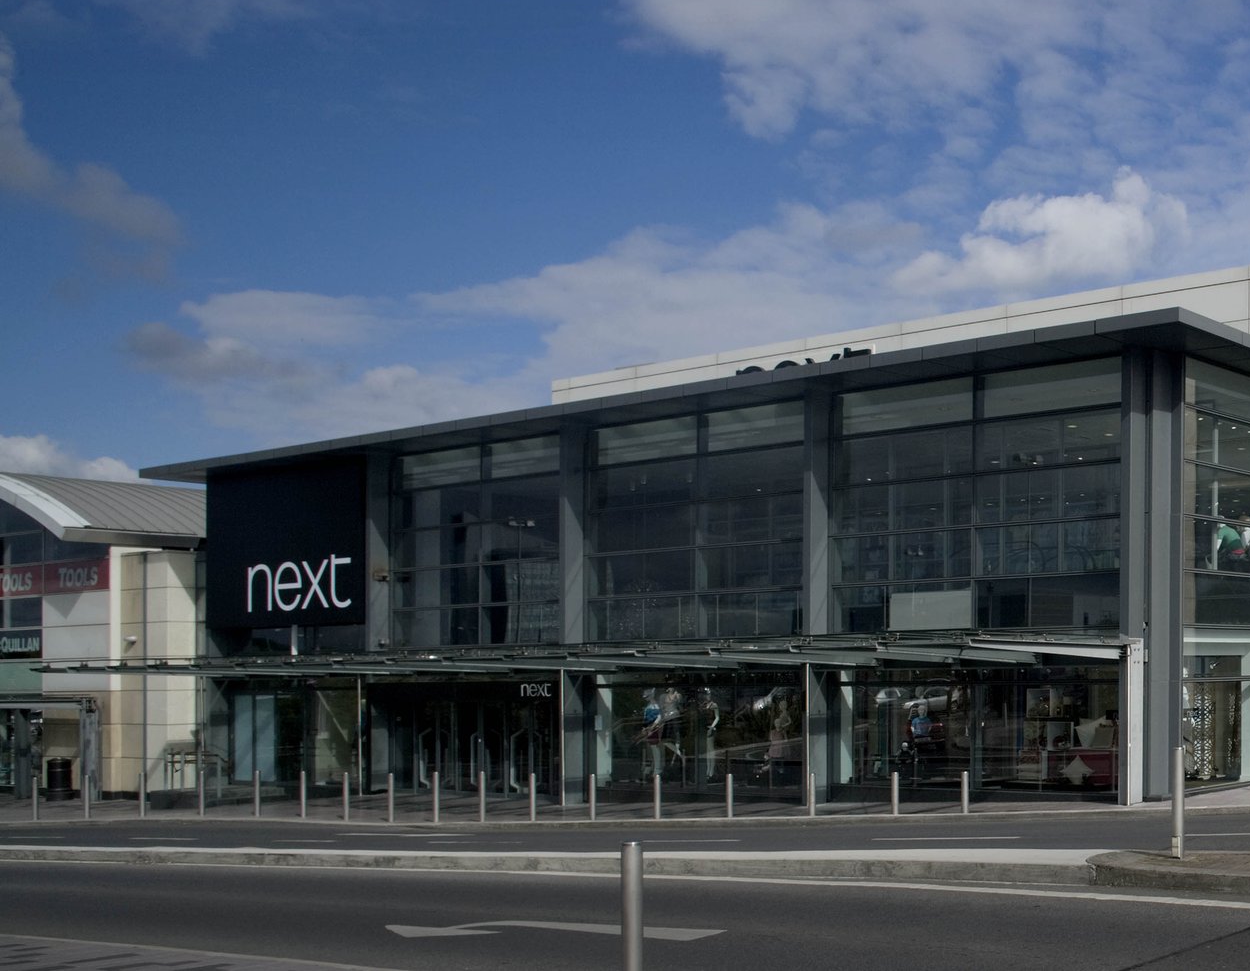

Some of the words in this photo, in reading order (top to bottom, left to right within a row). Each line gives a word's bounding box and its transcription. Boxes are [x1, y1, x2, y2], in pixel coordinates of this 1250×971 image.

[58, 566, 98, 588] TOOLS
[247, 554, 352, 613] next
[0, 636, 40, 652] QUILLAN
[520, 682, 552, 697] next
